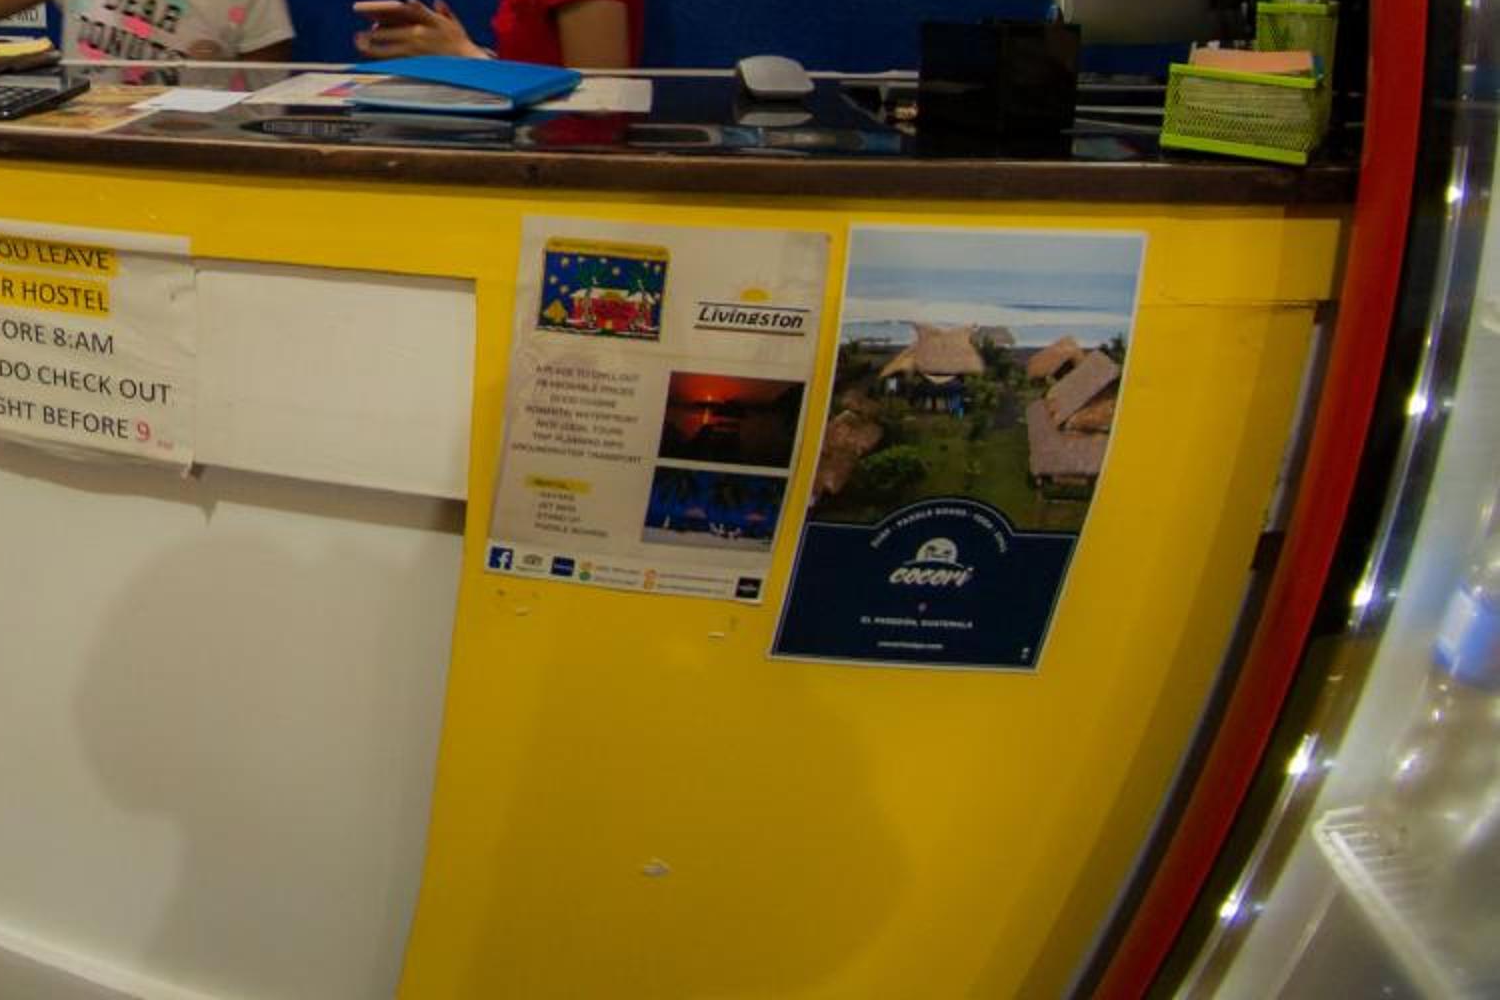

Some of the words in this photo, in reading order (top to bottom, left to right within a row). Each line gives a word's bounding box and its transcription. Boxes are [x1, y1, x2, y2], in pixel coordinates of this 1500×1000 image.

[40, 241, 110, 271] LEAVE
[23, 280, 110, 313] HOSTEL
[698, 305, 804, 330] Livingston
[53, 327, 114, 355] 8:AM
[0, 360, 31, 382] DO
[37, 366, 112, 396] CHECK
[119, 379, 171, 404] OUT
[43, 406, 129, 440] BEFORE
[136, 422, 150, 441] 9
